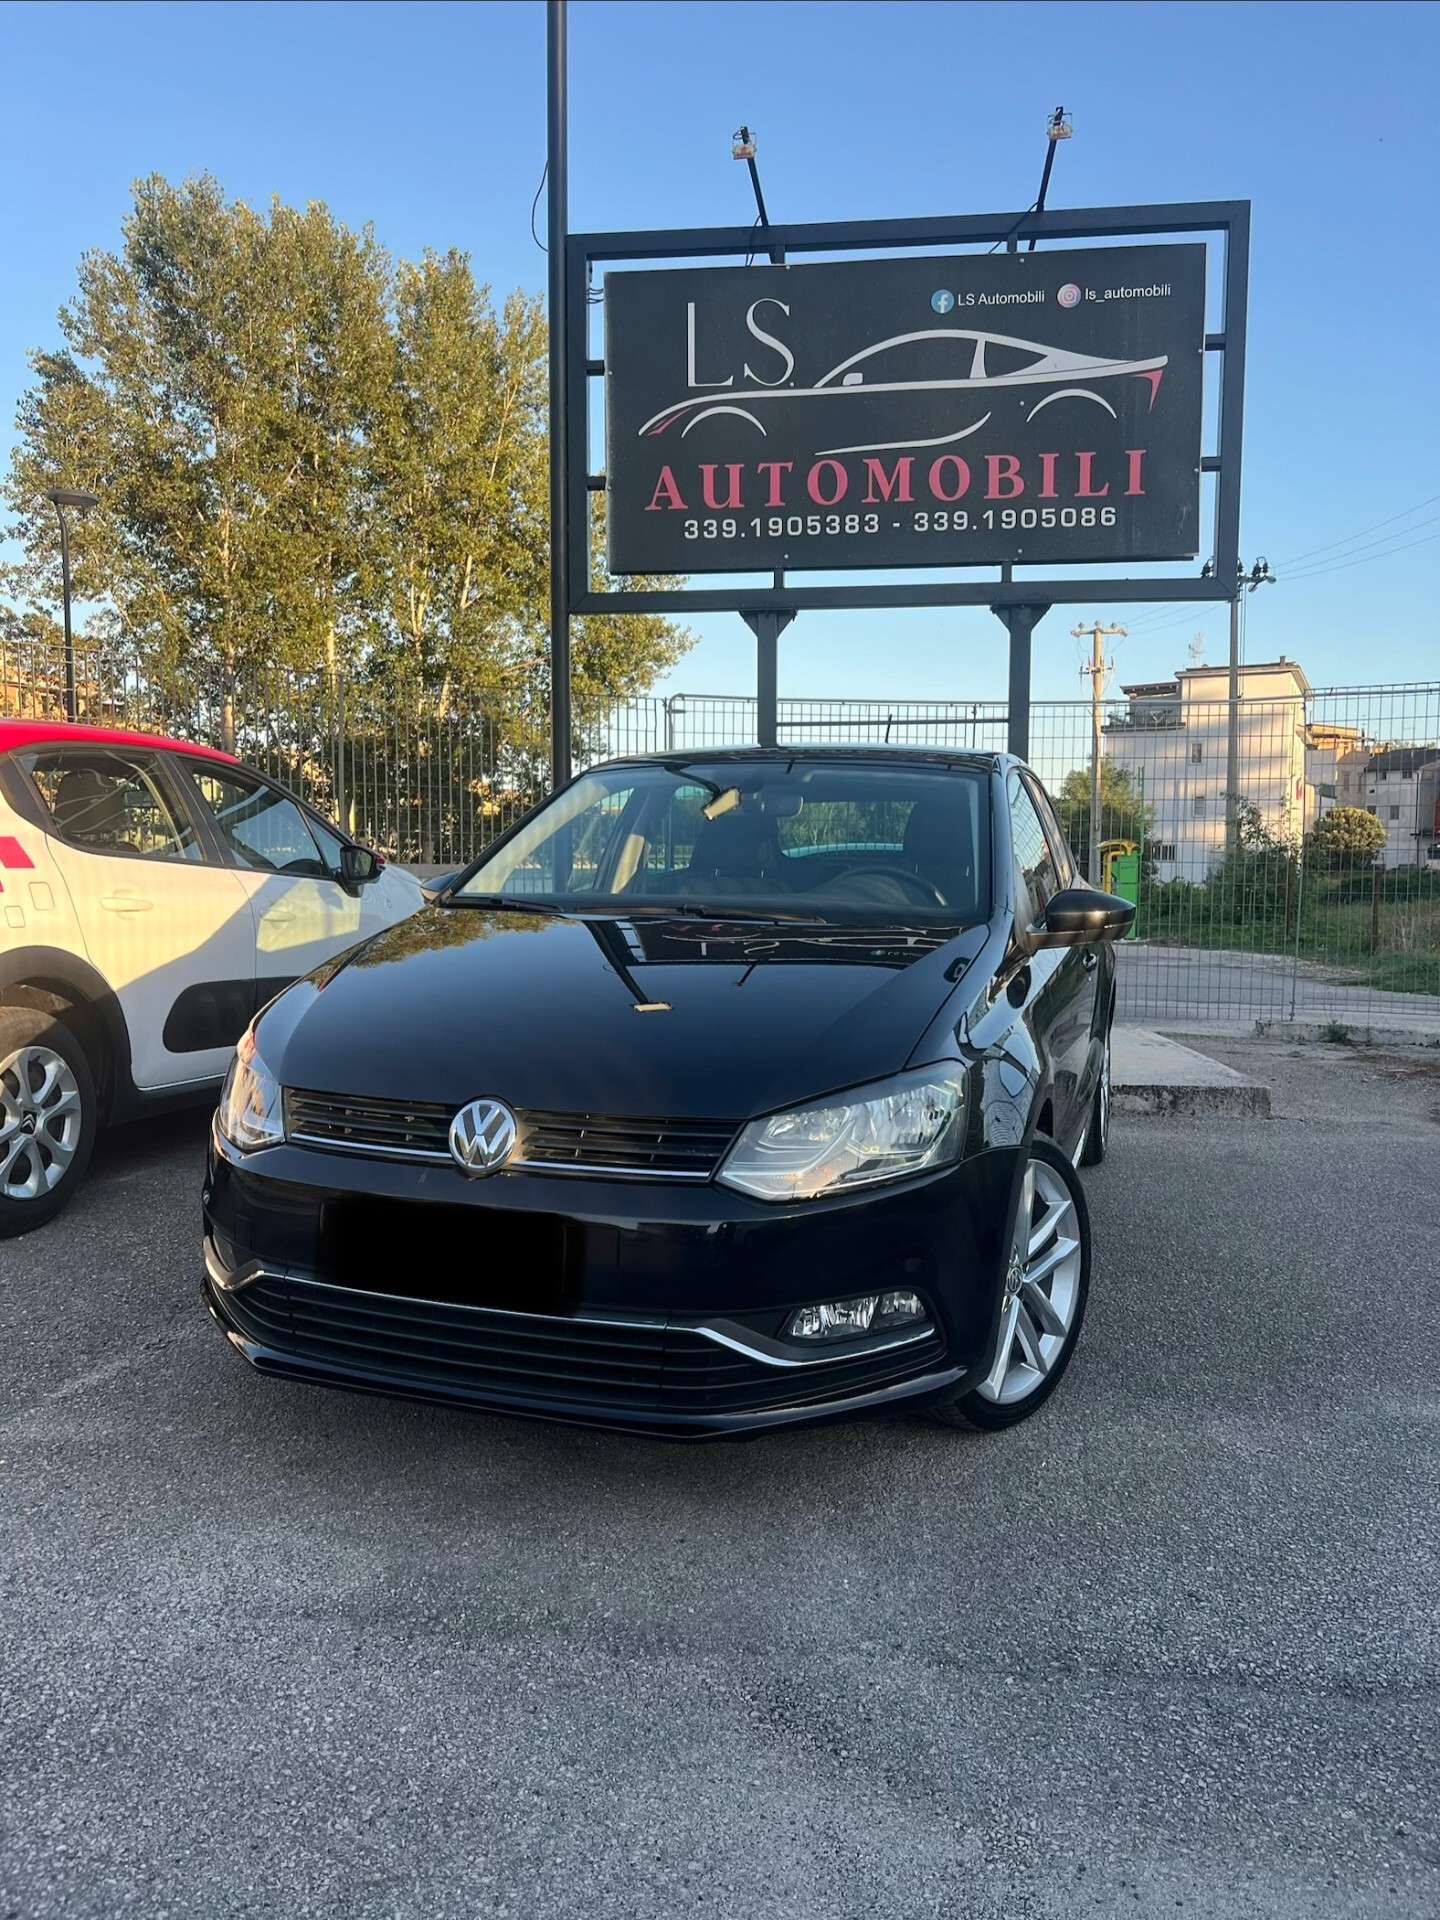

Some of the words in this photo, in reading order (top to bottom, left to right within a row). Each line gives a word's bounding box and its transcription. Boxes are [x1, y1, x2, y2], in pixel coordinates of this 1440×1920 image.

[957, 293, 975, 306] LS
[978, 289, 1045, 306] Automobili
[1084, 283, 1171, 303] ls_automobili
[645, 449, 1147, 511] AUTOMOBILI
[684, 513, 880, 539] 339.1905383
[913, 507, 1117, 531] 339.1905086
